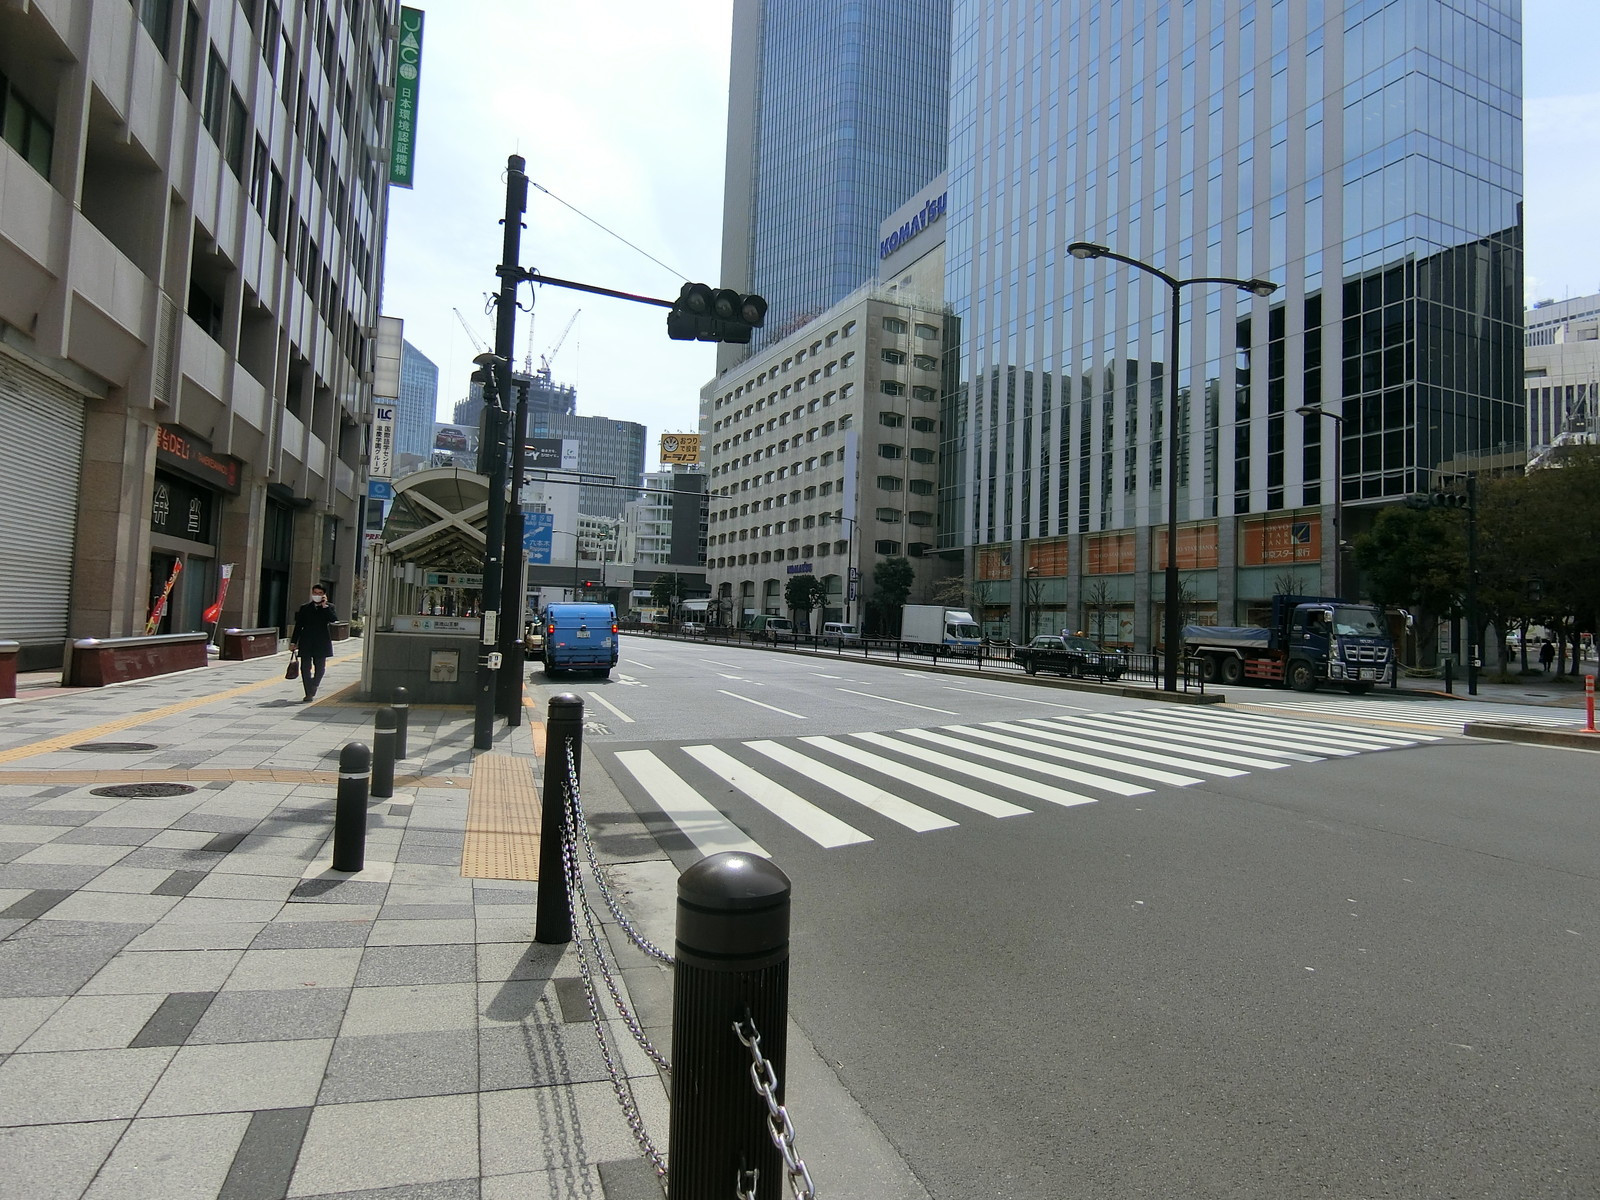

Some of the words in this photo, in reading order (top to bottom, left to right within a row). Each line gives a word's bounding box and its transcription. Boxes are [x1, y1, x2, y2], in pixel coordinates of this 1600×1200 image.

[395, 87, 411, 176] 日本環境認証機構
[880, 191, 947, 259] KOMATSU
[377, 408, 392, 420] ILC
[680, 437, 698, 445] おつり
[680, 445, 698, 453] で投資
